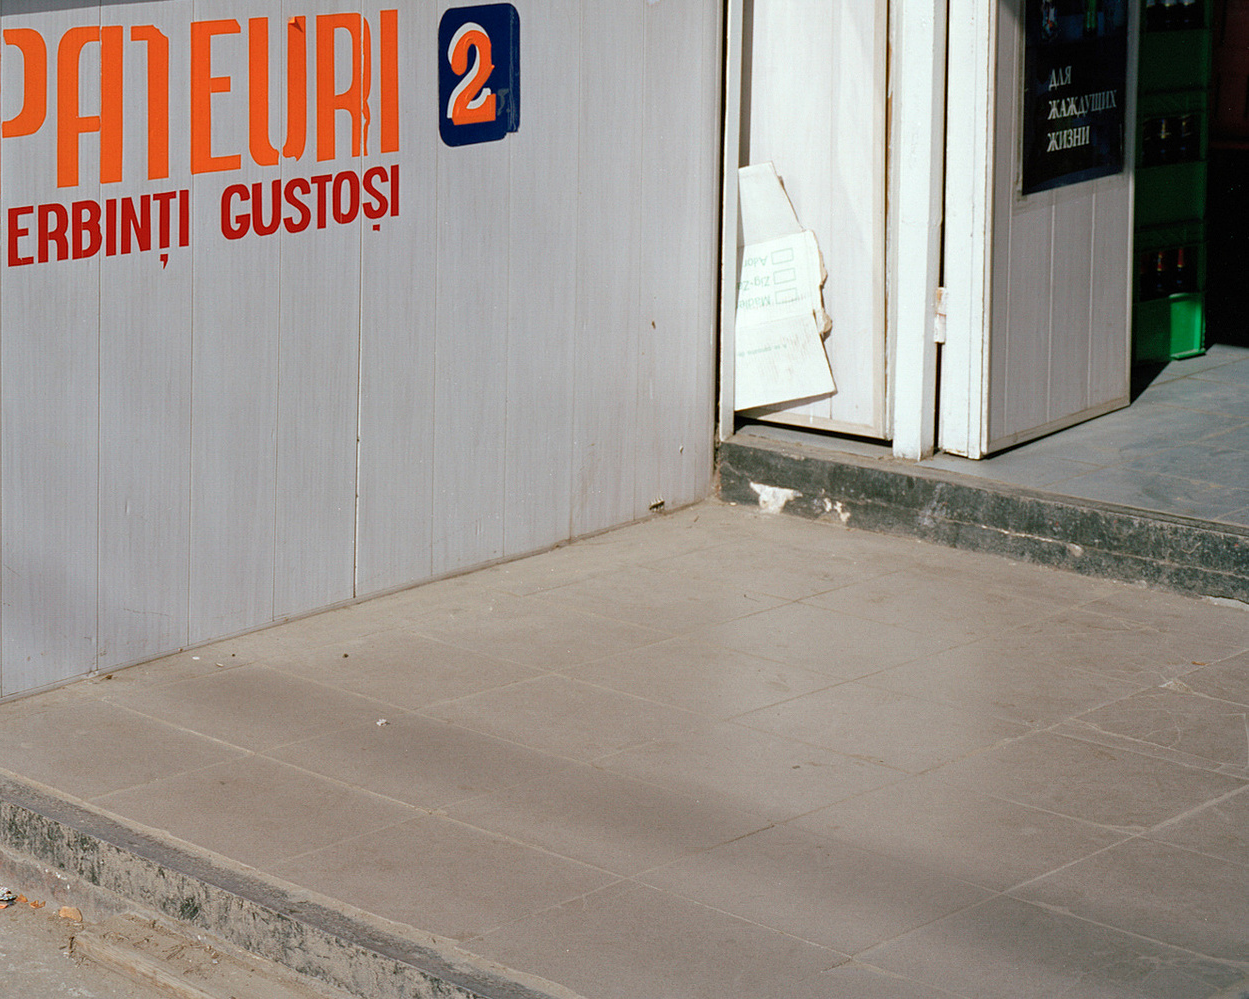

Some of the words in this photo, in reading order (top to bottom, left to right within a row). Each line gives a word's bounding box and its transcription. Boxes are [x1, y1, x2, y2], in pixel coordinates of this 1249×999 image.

[1048, 65, 1072, 91] ДЛЯ
[1046, 125, 1090, 153] ЖИЗНИ
[220, 164, 400, 240] GUSTOȘI
